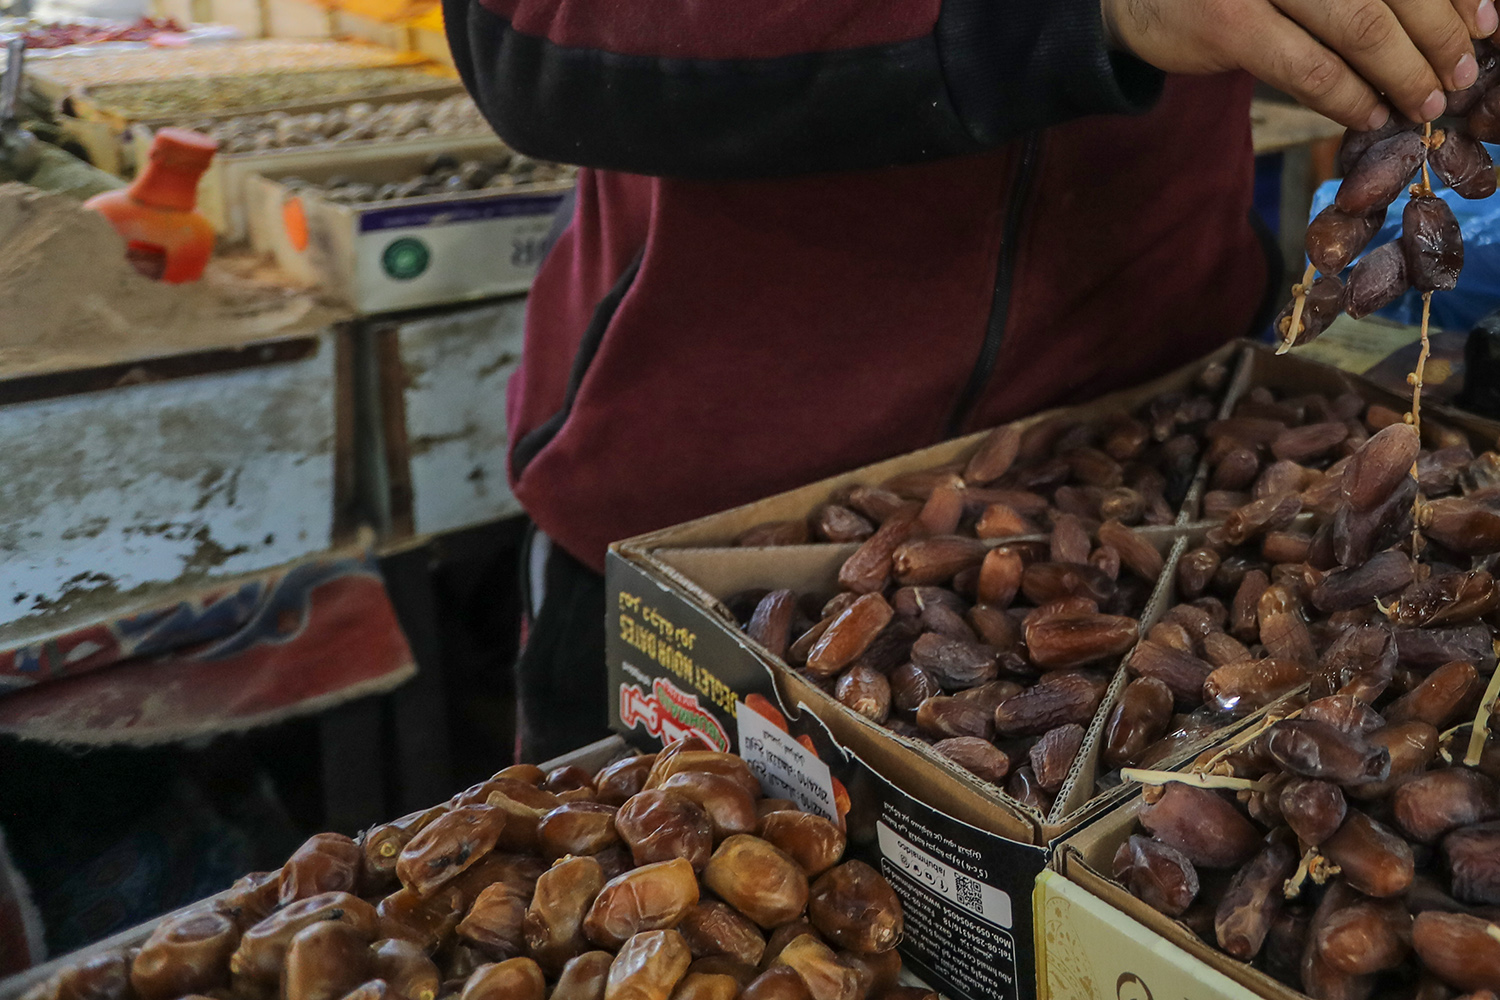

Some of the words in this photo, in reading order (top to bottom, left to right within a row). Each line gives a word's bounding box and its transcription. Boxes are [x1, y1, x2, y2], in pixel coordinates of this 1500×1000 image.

[619, 614, 657, 661] DATES
[657, 640, 694, 686] NOUR
[897, 839, 946, 878] /abuhmaidco
[991, 932, 1011, 948] Mob.
[998, 947, 1012, 961] Tel:
[998, 971, 1011, 984] Abu
